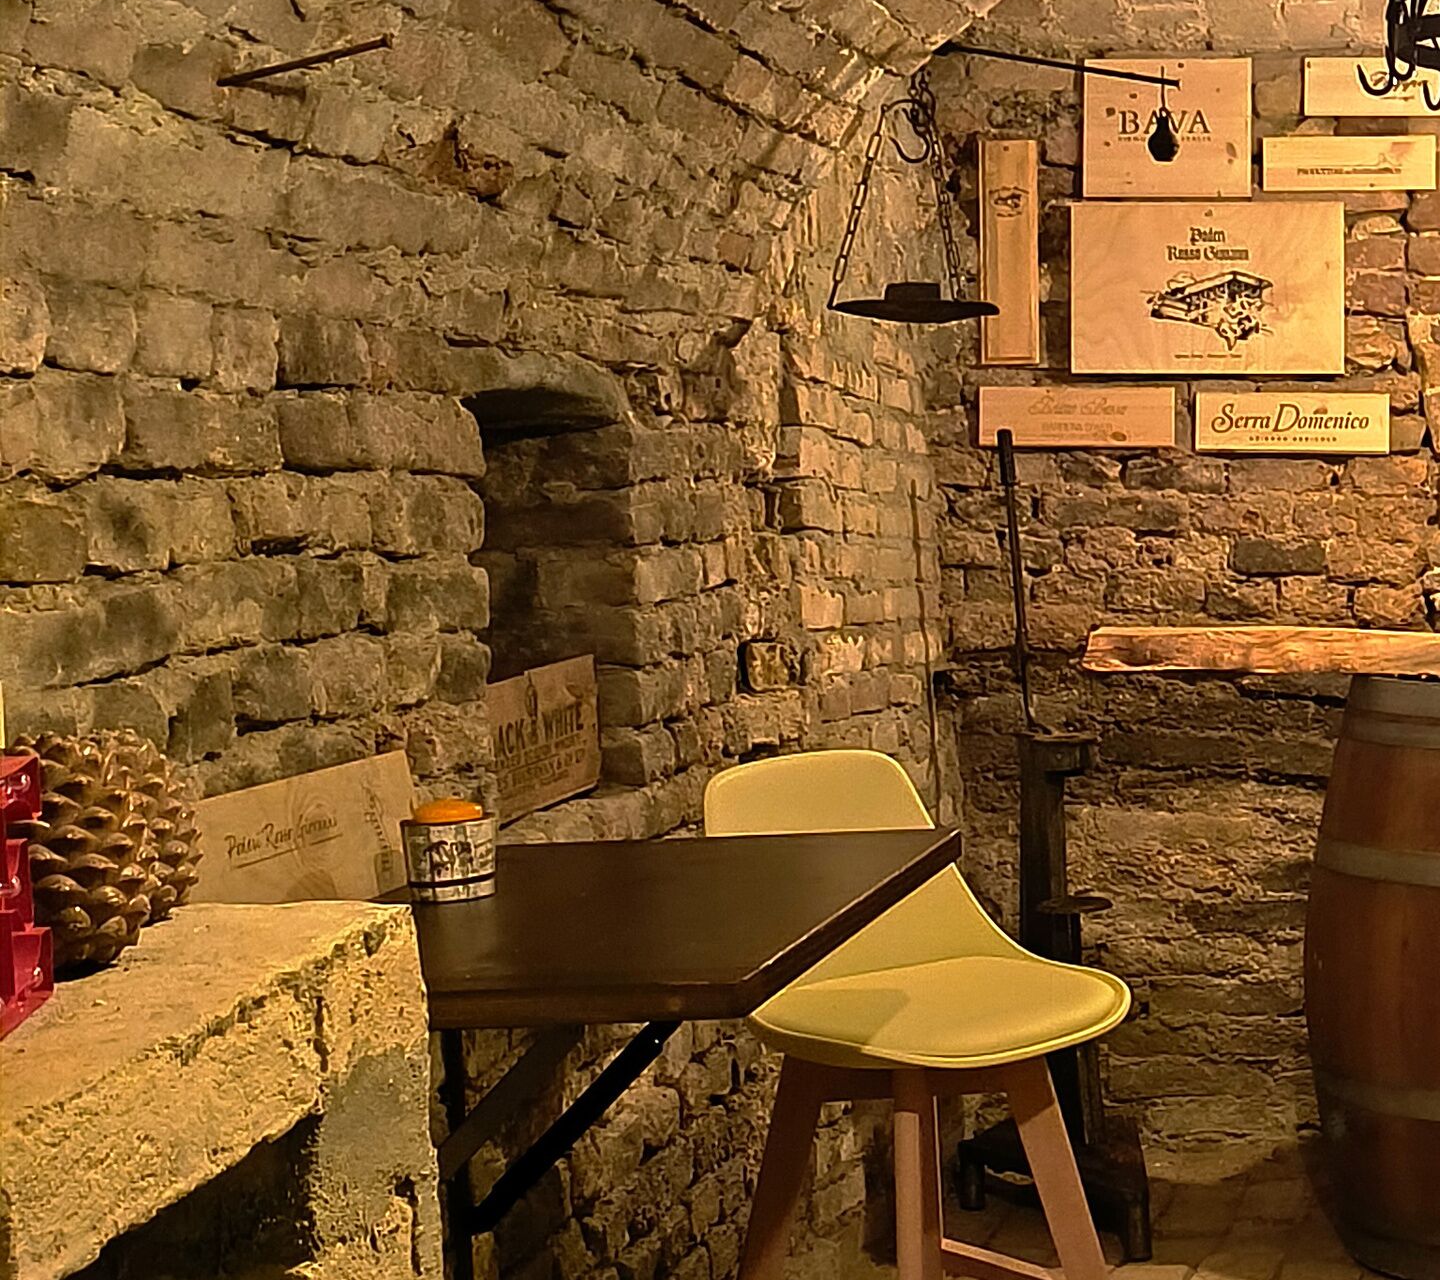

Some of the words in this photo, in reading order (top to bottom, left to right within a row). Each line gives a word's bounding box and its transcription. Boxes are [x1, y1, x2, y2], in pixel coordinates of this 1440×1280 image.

[1118, 109, 1210, 134] BAVA
[1210, 402, 1270, 434] Serra
[1271, 402, 1370, 433] Domenico
